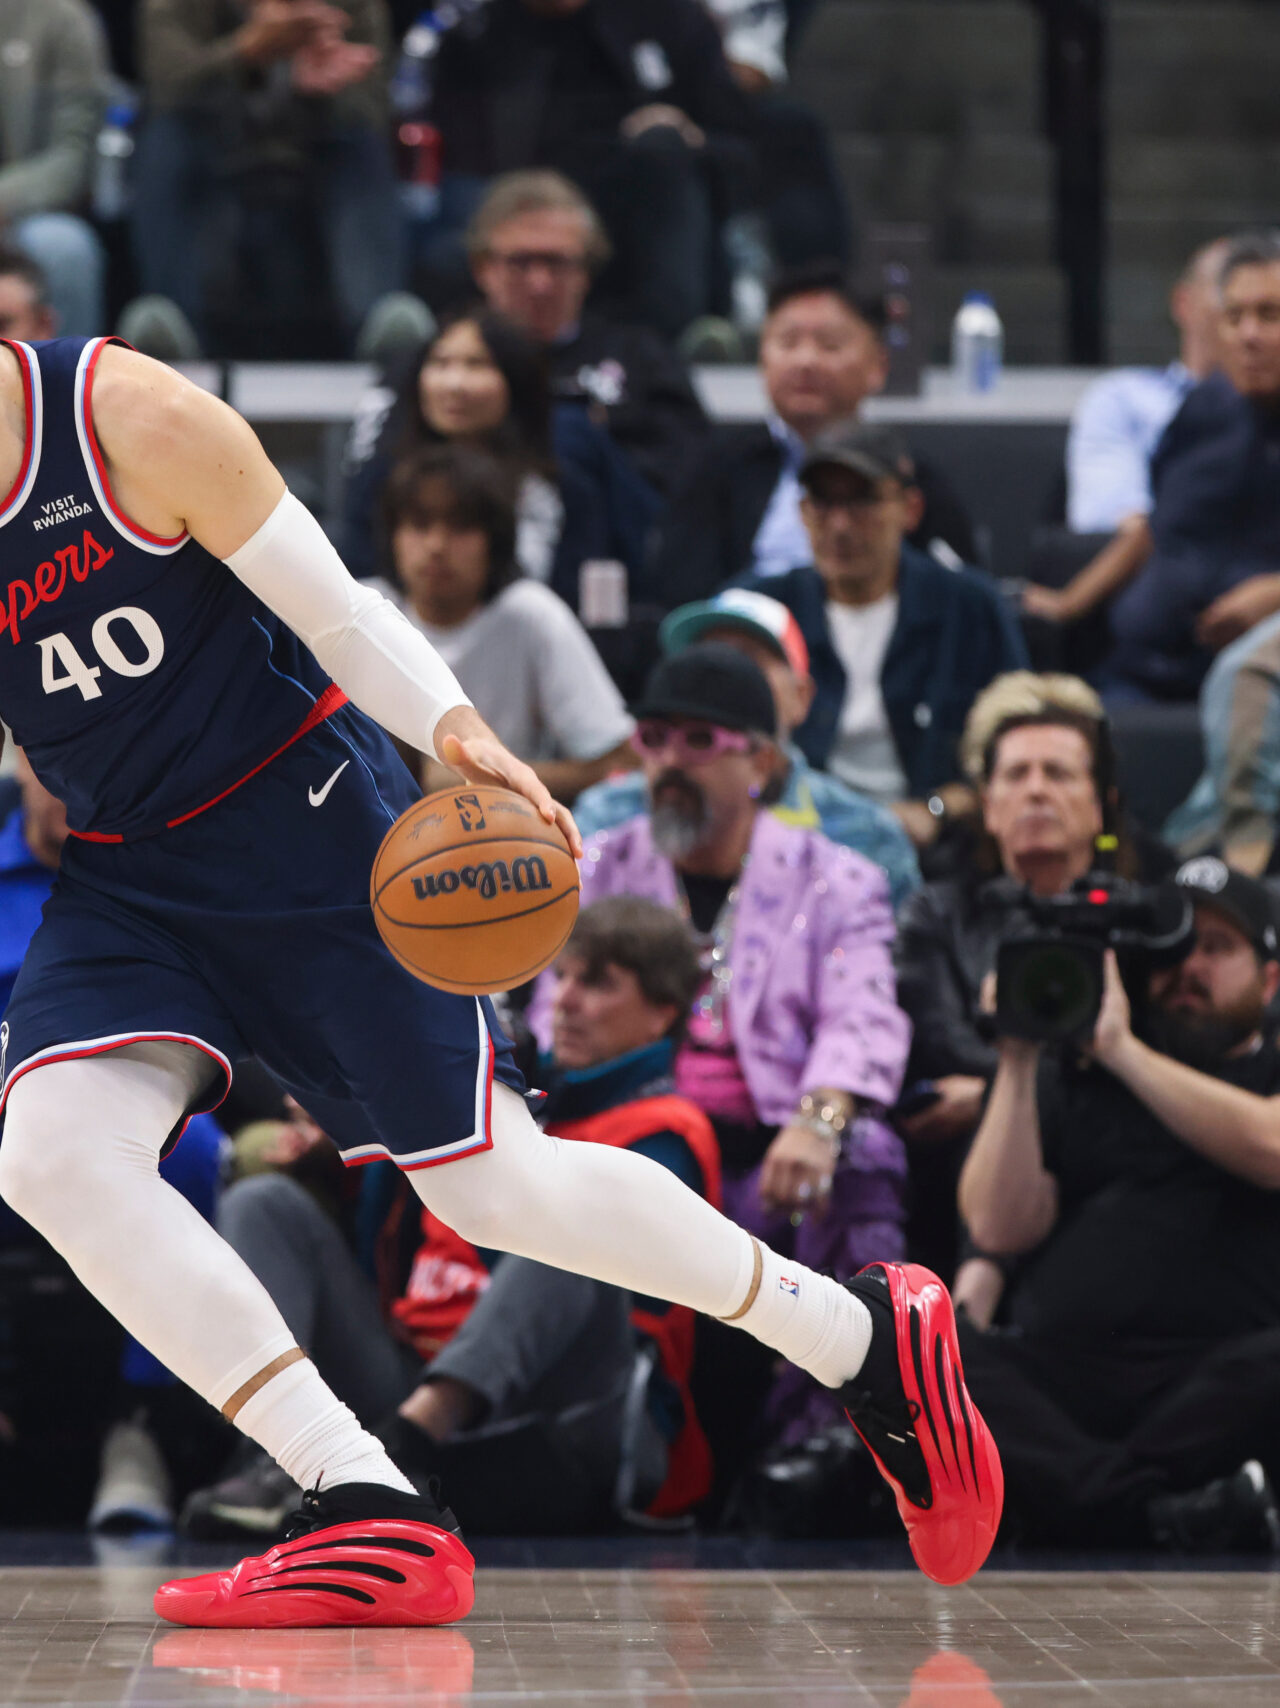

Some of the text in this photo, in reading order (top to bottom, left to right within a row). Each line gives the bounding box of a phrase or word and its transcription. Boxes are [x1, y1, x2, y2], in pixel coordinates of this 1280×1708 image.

[33, 502, 93, 531] RWANDA
[41, 494, 75, 515] VISIT
[35, 606, 164, 701] 40
[410, 854, 553, 900] Wilson
